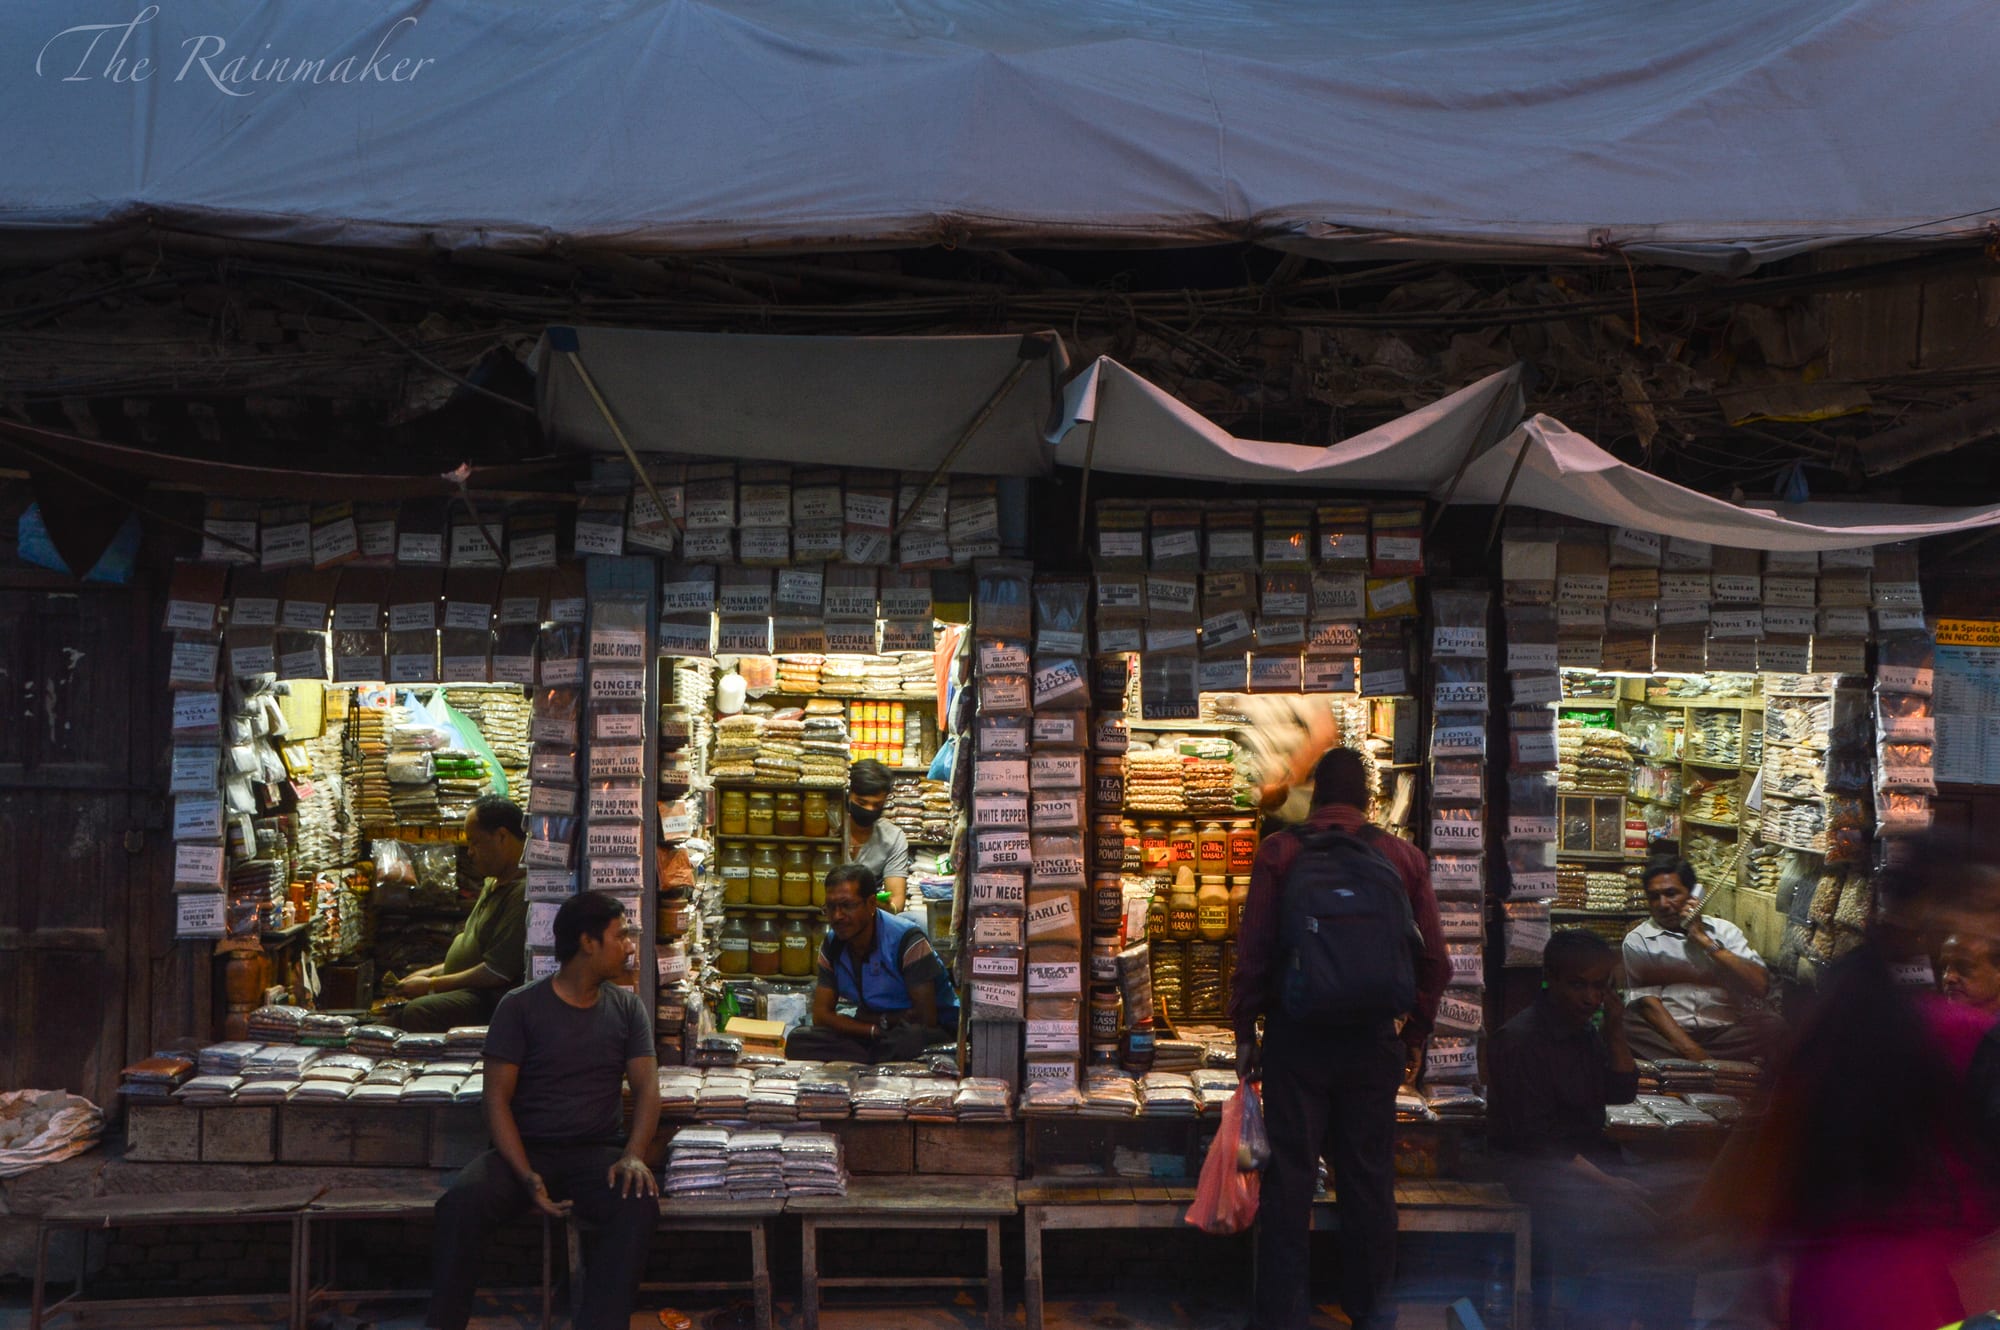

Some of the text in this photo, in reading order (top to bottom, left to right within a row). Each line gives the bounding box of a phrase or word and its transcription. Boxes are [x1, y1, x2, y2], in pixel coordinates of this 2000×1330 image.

[696, 516, 720, 524] TEA
[759, 546, 775, 554] TEA
[1563, 582, 1604, 590] GINGER
[1717, 583, 1755, 592] GARLIC
[678, 592, 713, 602] VEGETABLE
[1315, 590, 1357, 600] VANILLA
[1561, 592, 1606, 600] POWDER
[1712, 592, 1761, 602] POWDER
[669, 601, 707, 609] MASALA
[721, 595, 770, 606] CINNAMON
[827, 598, 874, 608] TEA AND COFFEE
[830, 607, 869, 615] MASALA
[1560, 608, 1602, 616] ILAM TEA
[1712, 619, 1743, 630] NEPAL
[1763, 616, 1796, 626] GREEN
[1951, 624, 1960, 632] &
[1960, 623, 1991, 636] Spices
[1992, 625, 2000, 634] C
[826, 635, 874, 645] VEGETABLE
[911, 633, 931, 642] MEAT
[659, 636, 708, 651] SAFFRON FLOWER
[719, 636, 767, 649] MEAT MASALA
[800, 637, 823, 651] POWDER
[906, 642, 931, 650] MASALA
[1437, 638, 1487, 648] PEPPER
[592, 643, 642, 658] GARLIC POWDER
[985, 661, 1025, 669] CARDAMON
[593, 680, 642, 690] GINGER
[1436, 685, 1486, 694] BLACK
[598, 689, 636, 697] POWDER
[1435, 693, 1487, 702] PEPPER
[1144, 703, 1199, 718] SAFFRON
[1441, 731, 1473, 739] LONG
[1432, 736, 1482, 748] PEPPER
[1056, 760, 1079, 769] SOUP
[591, 767, 640, 775] CAKE MASALA
[1099, 778, 1121, 788] TEA
[1887, 775, 1931, 785] GINGER
[1097, 791, 1122, 803] MASALA
[591, 800, 603, 809] FISH
[605, 800, 616, 809] AND
[1032, 802, 1072, 812] ONION
[977, 809, 1026, 823] WHITE PEPPER
[1433, 825, 1481, 839] GARLIC
[1513, 825, 1554, 834] ILAM TEA
[589, 835, 637, 844] GARAM MASALA
[590, 845, 637, 854] WITH SAFFRON
[979, 839, 1030, 853] BLACK PEPPER
[1173, 842, 1193, 850] MEAT
[1201, 845, 1224, 853] CURRY
[992, 852, 1019, 863] SEED
[592, 867, 640, 877] CHICKEN TANDOORI
[1033, 866, 1083, 875] POWDER
[1430, 862, 1479, 873] CINNAMON
[1511, 882, 1537, 891] NEPAL
[973, 885, 994, 900] NUT
[1098, 891, 1120, 899] CURRY
[1098, 898, 1120, 906] MASALA
[1028, 902, 1071, 922] GARLIC
[1170, 910, 1196, 920] GARAM
[183, 913, 214, 921] GREEN
[190, 919, 208, 927] TEA
[1170, 920, 1196, 931] MASALA
[1439, 919, 1479, 927] Star Anis
[983, 929, 995, 937] Star
[1029, 966, 1078, 975] MEAT
[985, 993, 999, 1001] TEA
[1093, 1016, 1117, 1025] LASSI
[1426, 1052, 1476, 1066] NUTMEG
[1028, 1065, 1073, 1074] VEGETABLE
